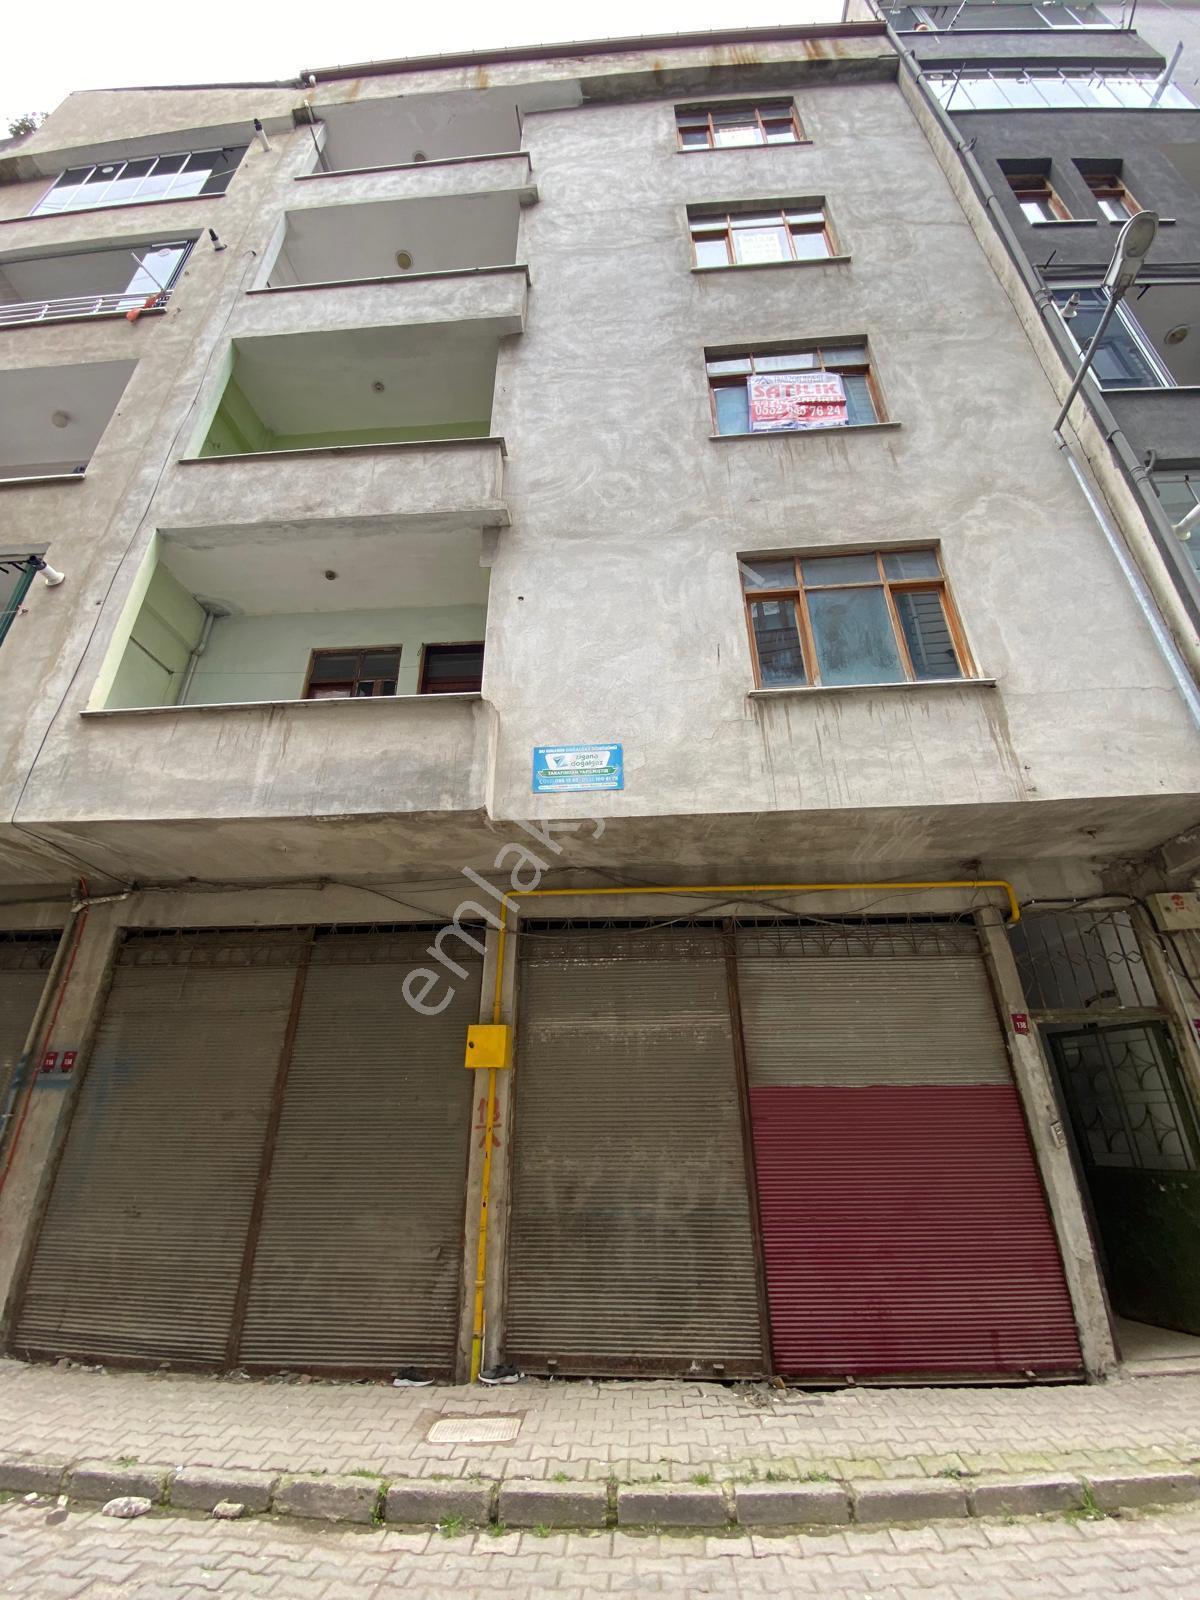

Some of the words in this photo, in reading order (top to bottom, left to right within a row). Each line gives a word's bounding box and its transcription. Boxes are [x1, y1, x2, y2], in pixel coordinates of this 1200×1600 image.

[753, 383, 836, 397] SATILIK
[811, 405, 824, 416] 76
[827, 404, 841, 415] 24
